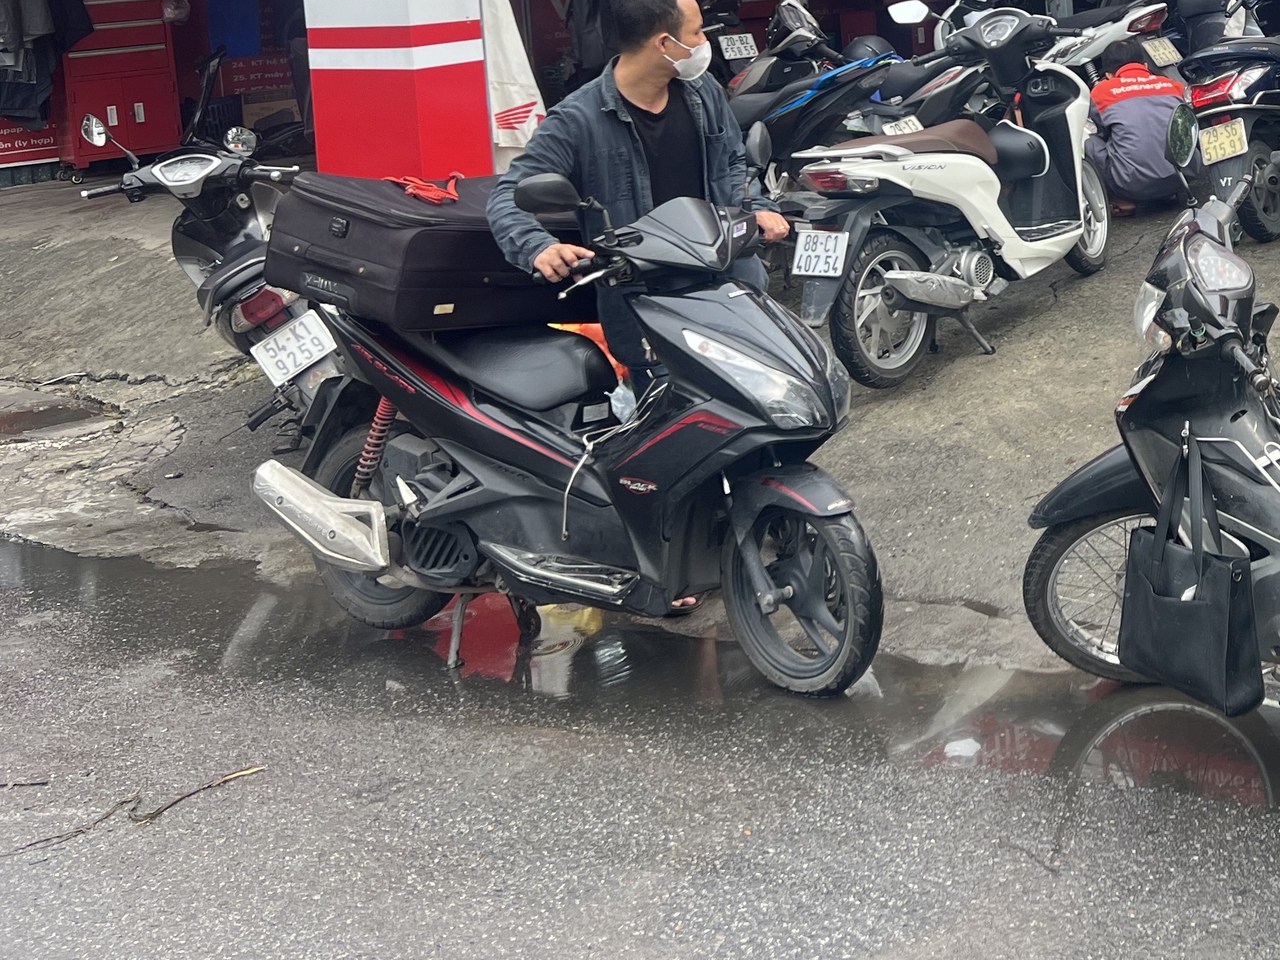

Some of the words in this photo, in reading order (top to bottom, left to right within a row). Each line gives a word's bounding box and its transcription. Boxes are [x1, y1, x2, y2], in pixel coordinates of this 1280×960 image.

[1110, 82, 1173, 95] TotalEnergies
[1205, 125, 1237, 145] 29-S6
[1205, 138, 1243, 161] 515.91
[1220, 177, 1232, 187] VT
[804, 234, 838, 255] 88-C1
[796, 251, 844, 276] 407.54
[262, 321, 311, 360] 54-K1
[275, 337, 326, 376] 9259
